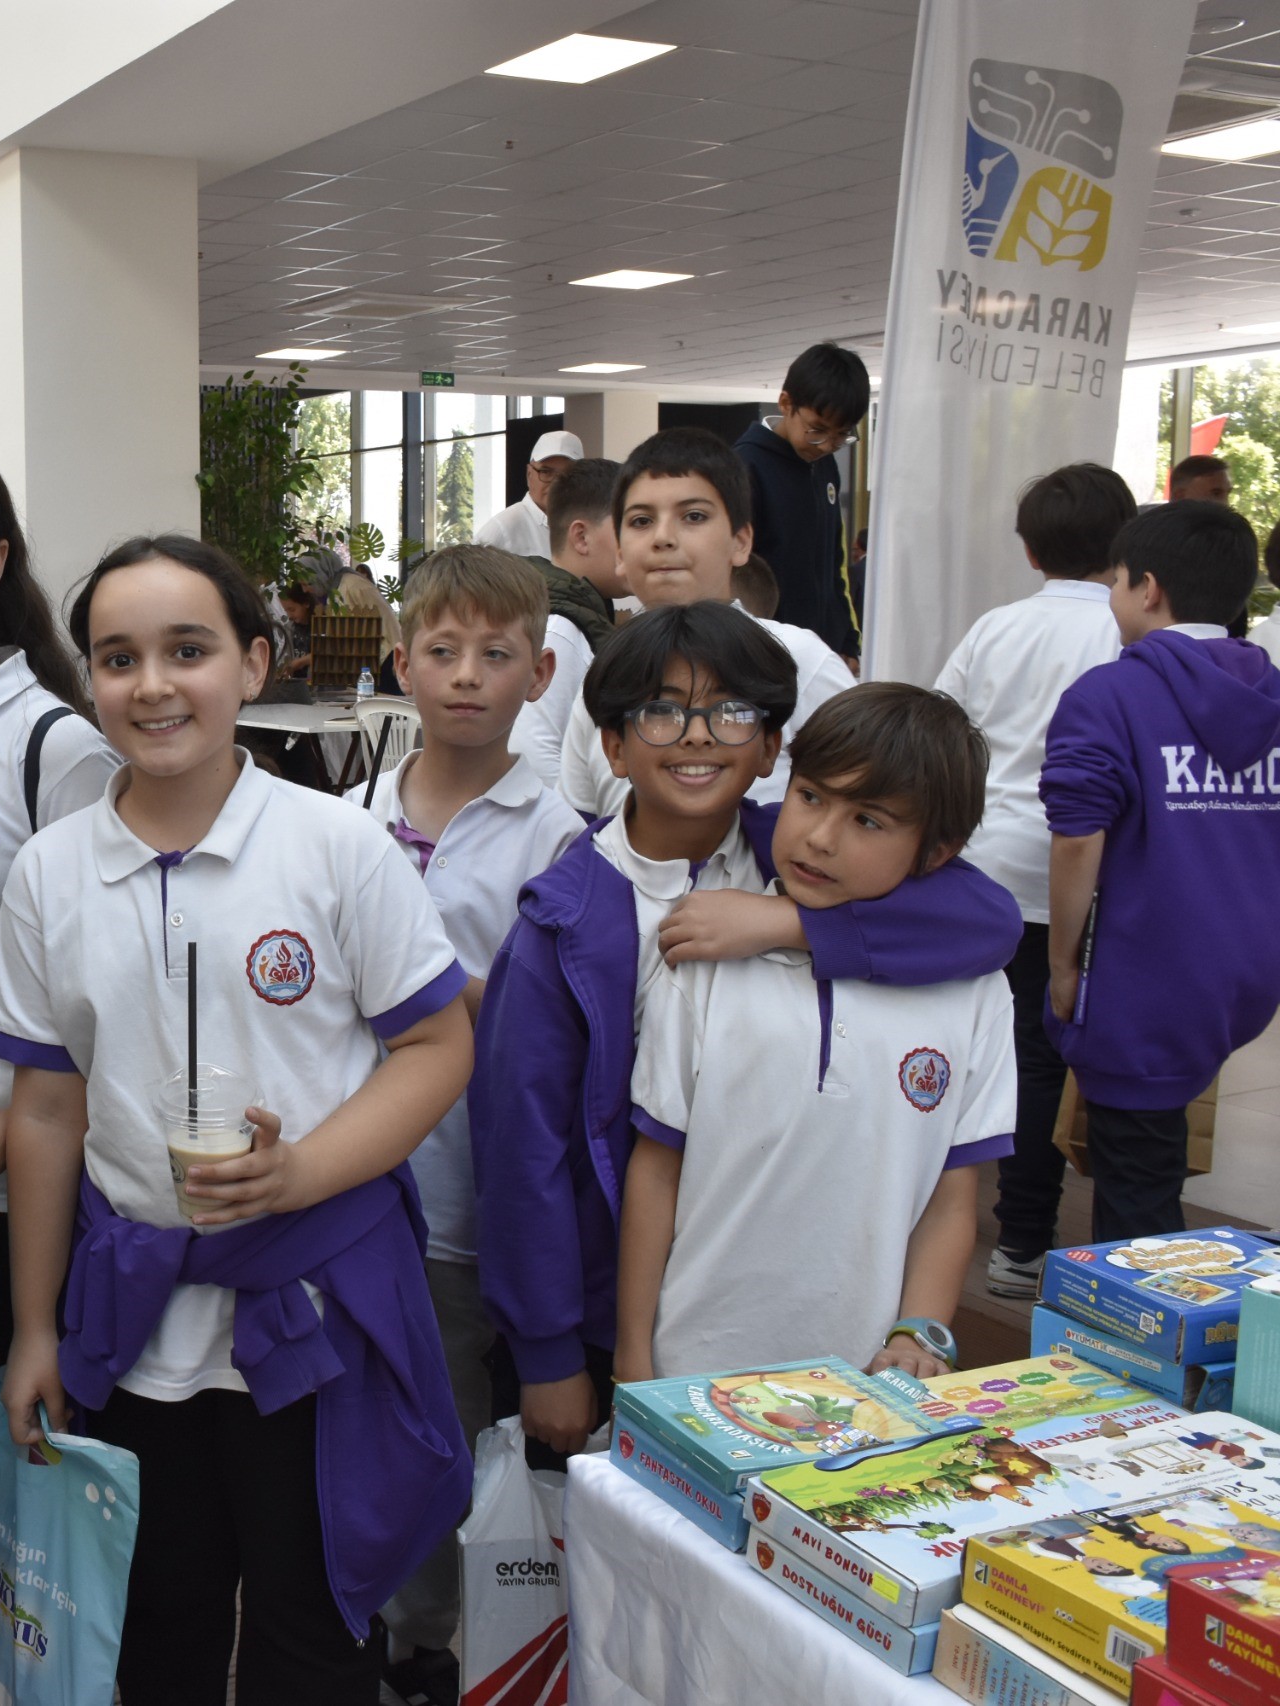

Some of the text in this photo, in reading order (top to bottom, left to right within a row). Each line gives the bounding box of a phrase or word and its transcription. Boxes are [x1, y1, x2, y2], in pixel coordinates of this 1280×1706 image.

[695, 1491, 723, 1521] OKUL
[792, 1526, 822, 1551] MAVİ
[496, 1557, 559, 1577] erdem
[991, 1567, 1028, 1593] DAMLA
[496, 1578, 525, 1587] YAYIN
[51, 1582, 77, 1617] için
[781, 1564, 892, 1651] DOSTLUĞUN GÜCÜ
[985, 1600, 1022, 1626] Çocuklara
[1022, 1622, 1055, 1647] Kitapları
[1057, 1640, 1092, 1665] Sevdiren
[1226, 1624, 1273, 1658] DAMLA
